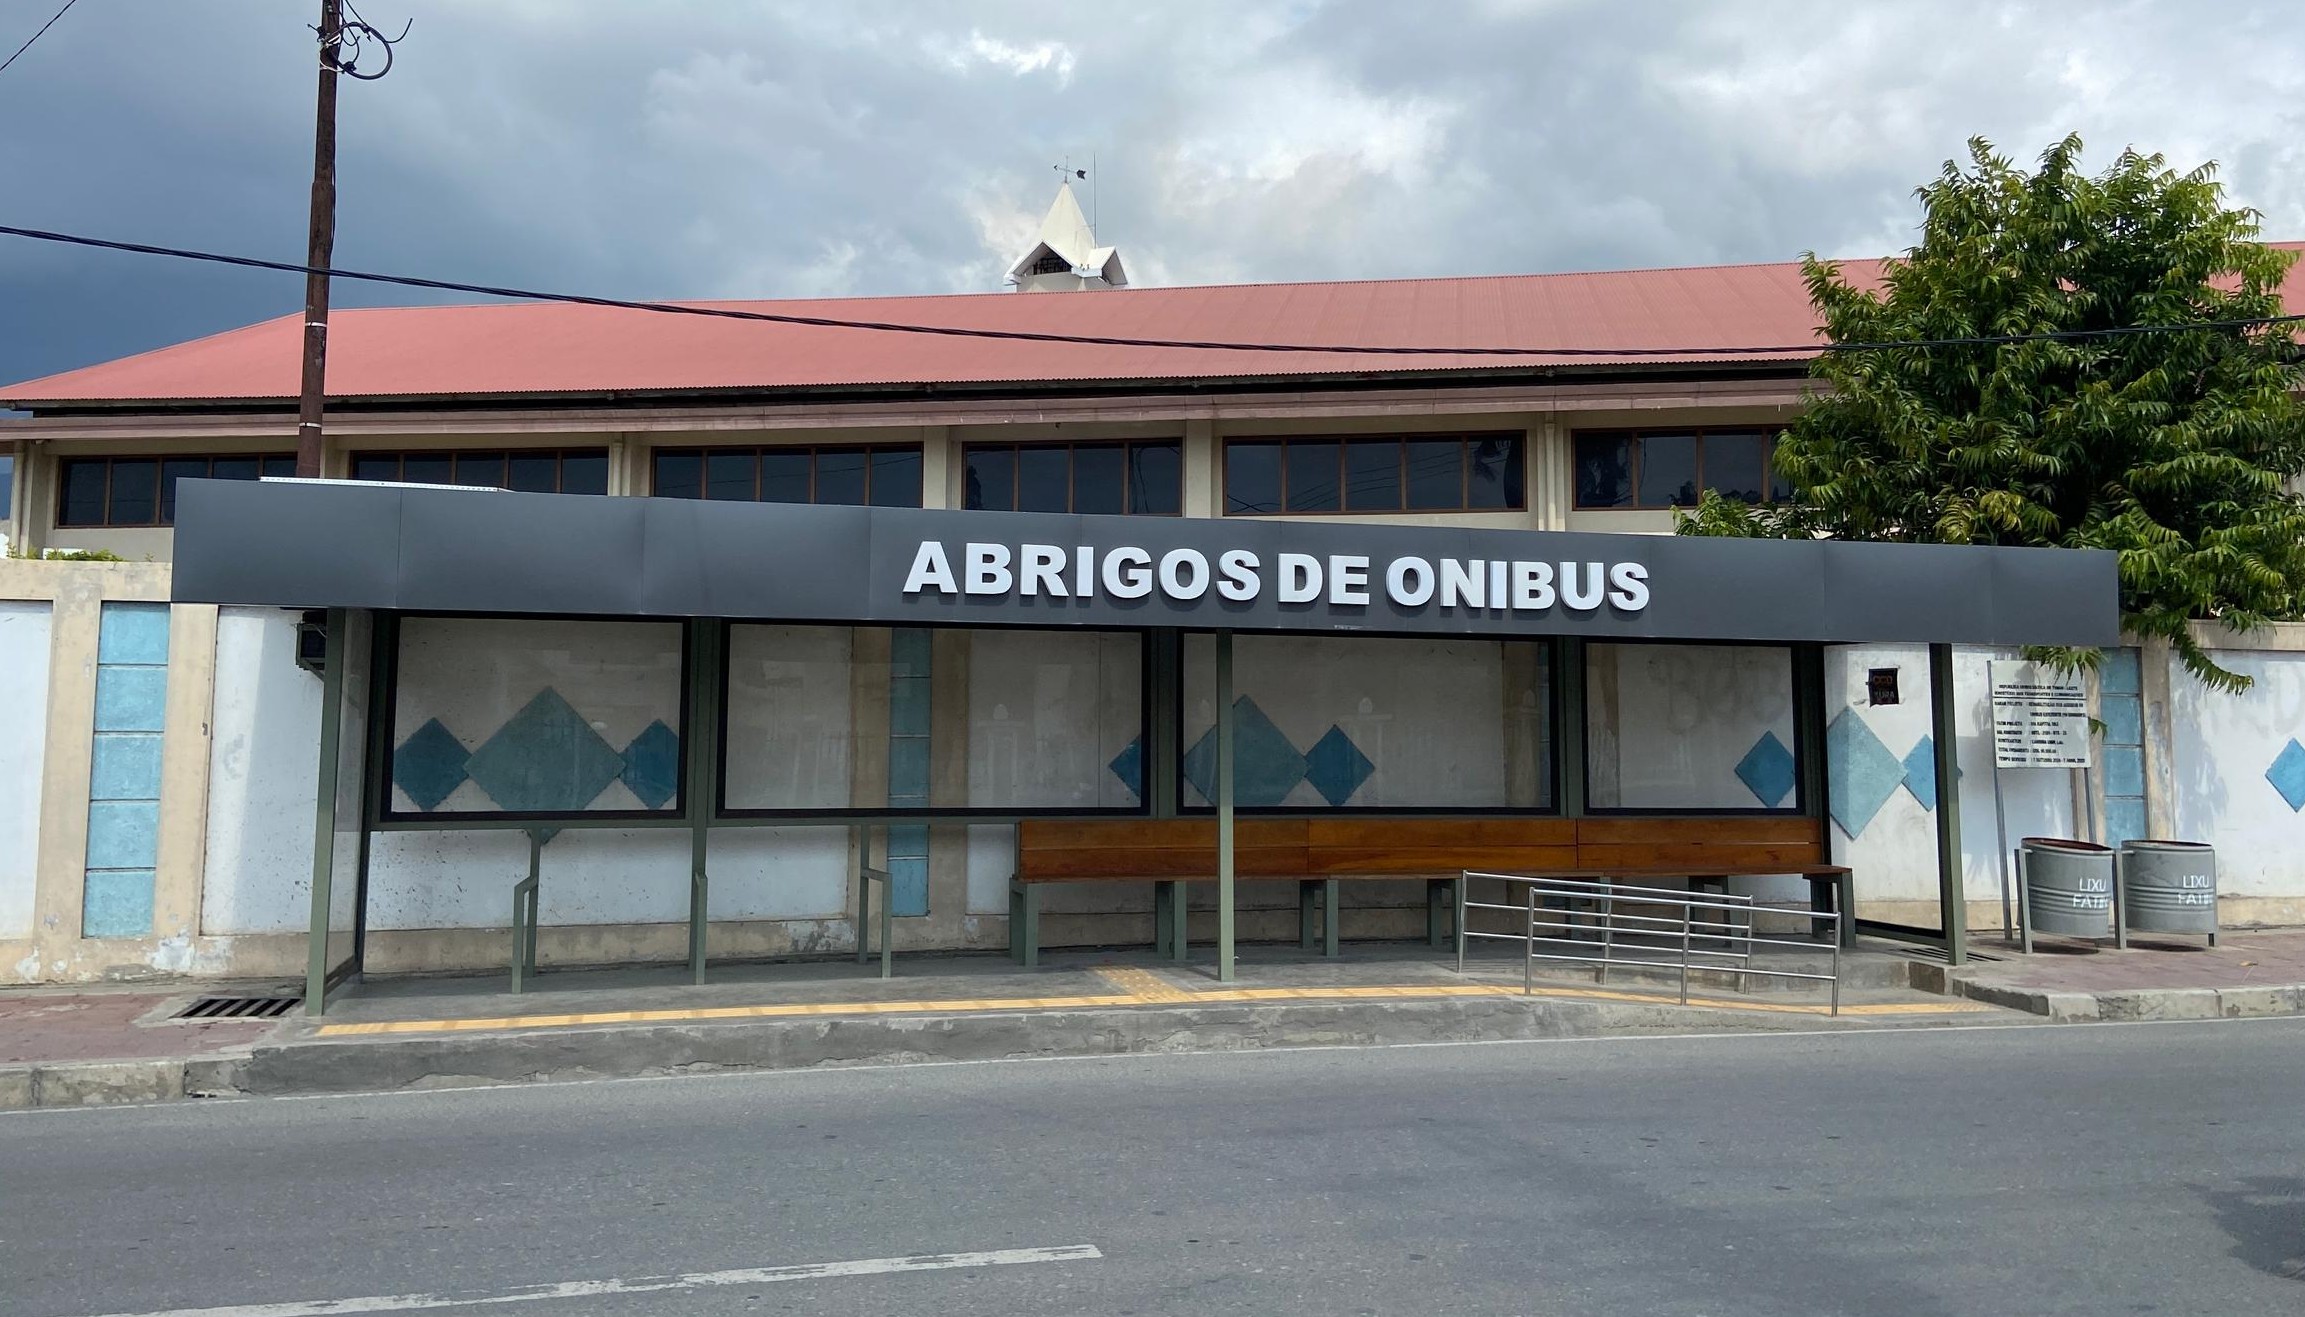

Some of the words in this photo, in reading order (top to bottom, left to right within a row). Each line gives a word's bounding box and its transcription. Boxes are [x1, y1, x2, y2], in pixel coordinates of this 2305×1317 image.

[902, 540, 1262, 602] ABRIGOS
[1278, 553, 1370, 605] DE
[1386, 556, 1650, 611] ONIBUS
[2079, 877, 2107, 892] LIXU
[2183, 874, 2210, 889] LIXU
